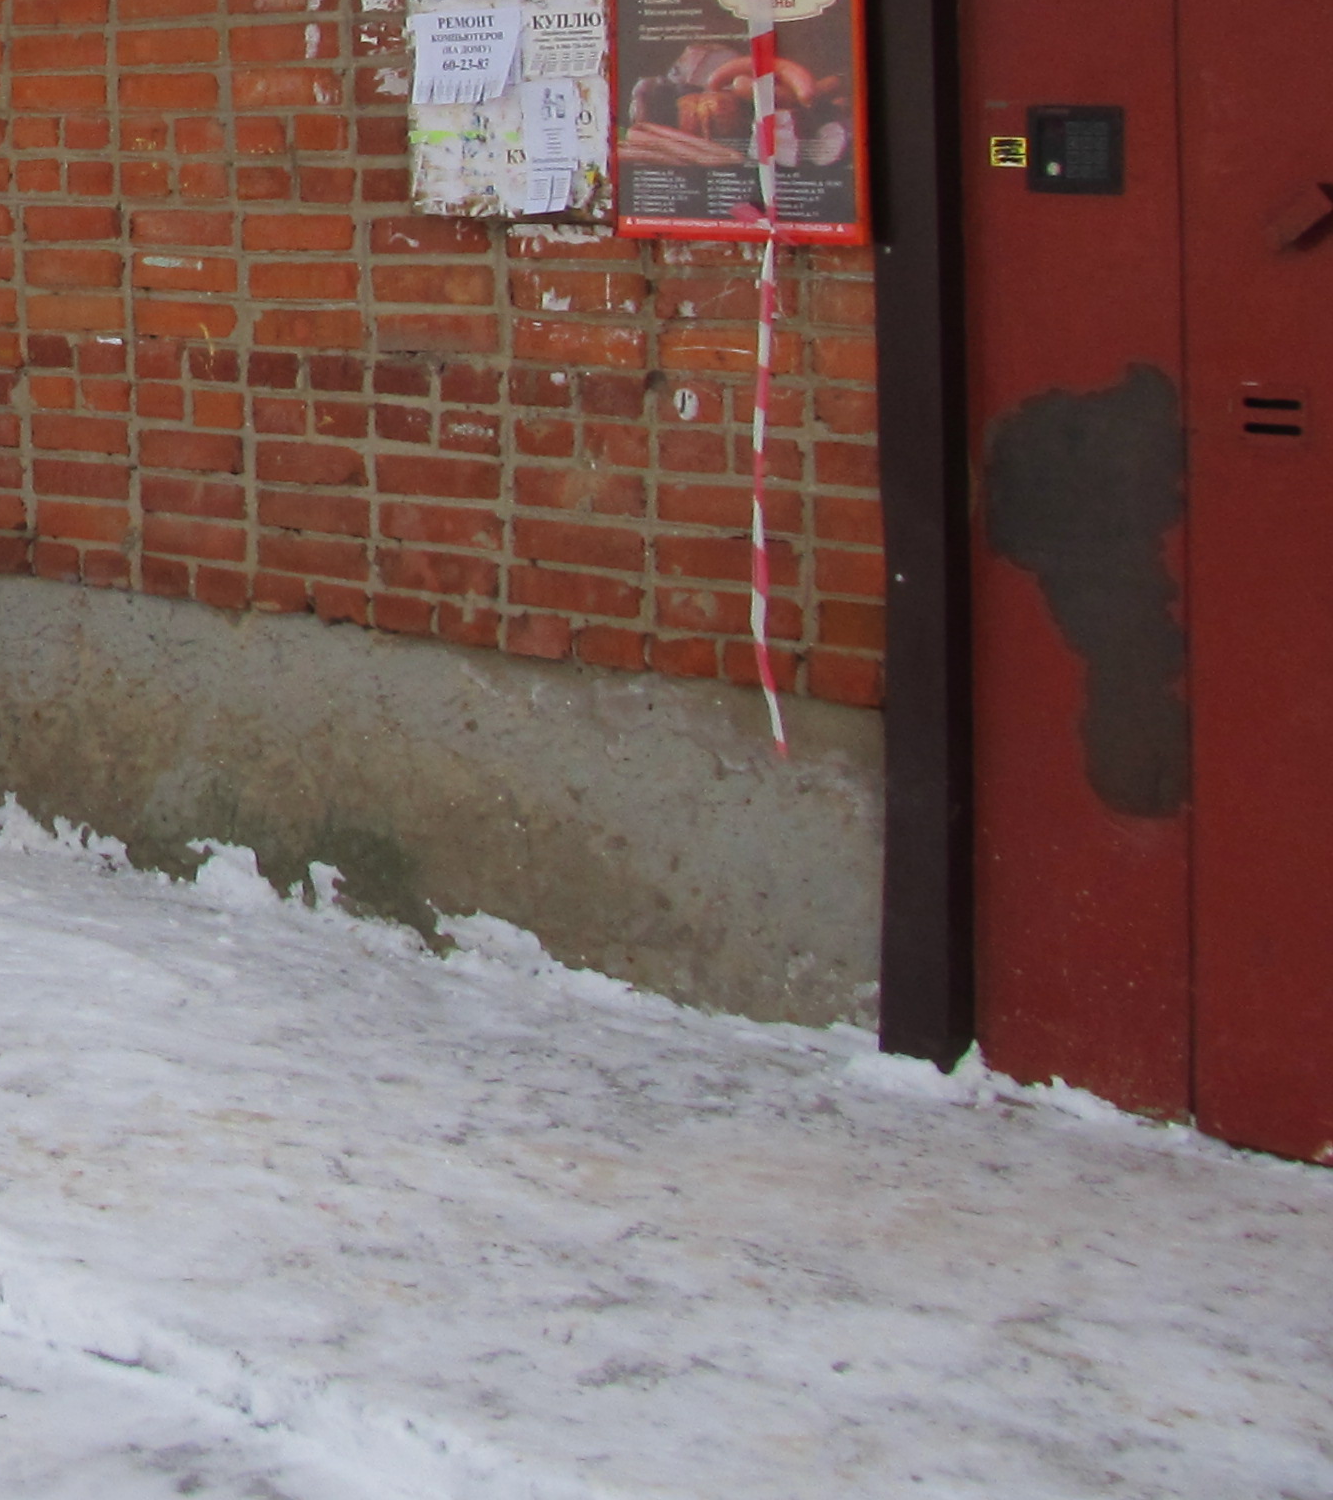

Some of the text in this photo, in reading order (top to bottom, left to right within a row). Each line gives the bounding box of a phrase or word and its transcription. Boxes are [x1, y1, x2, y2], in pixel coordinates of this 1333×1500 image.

[437, 15, 494, 29] РЕМОНТ
[533, 12, 601, 29] КУПЛЮ
[431, 31, 503, 42] КОМПЬЮТЕРОВ
